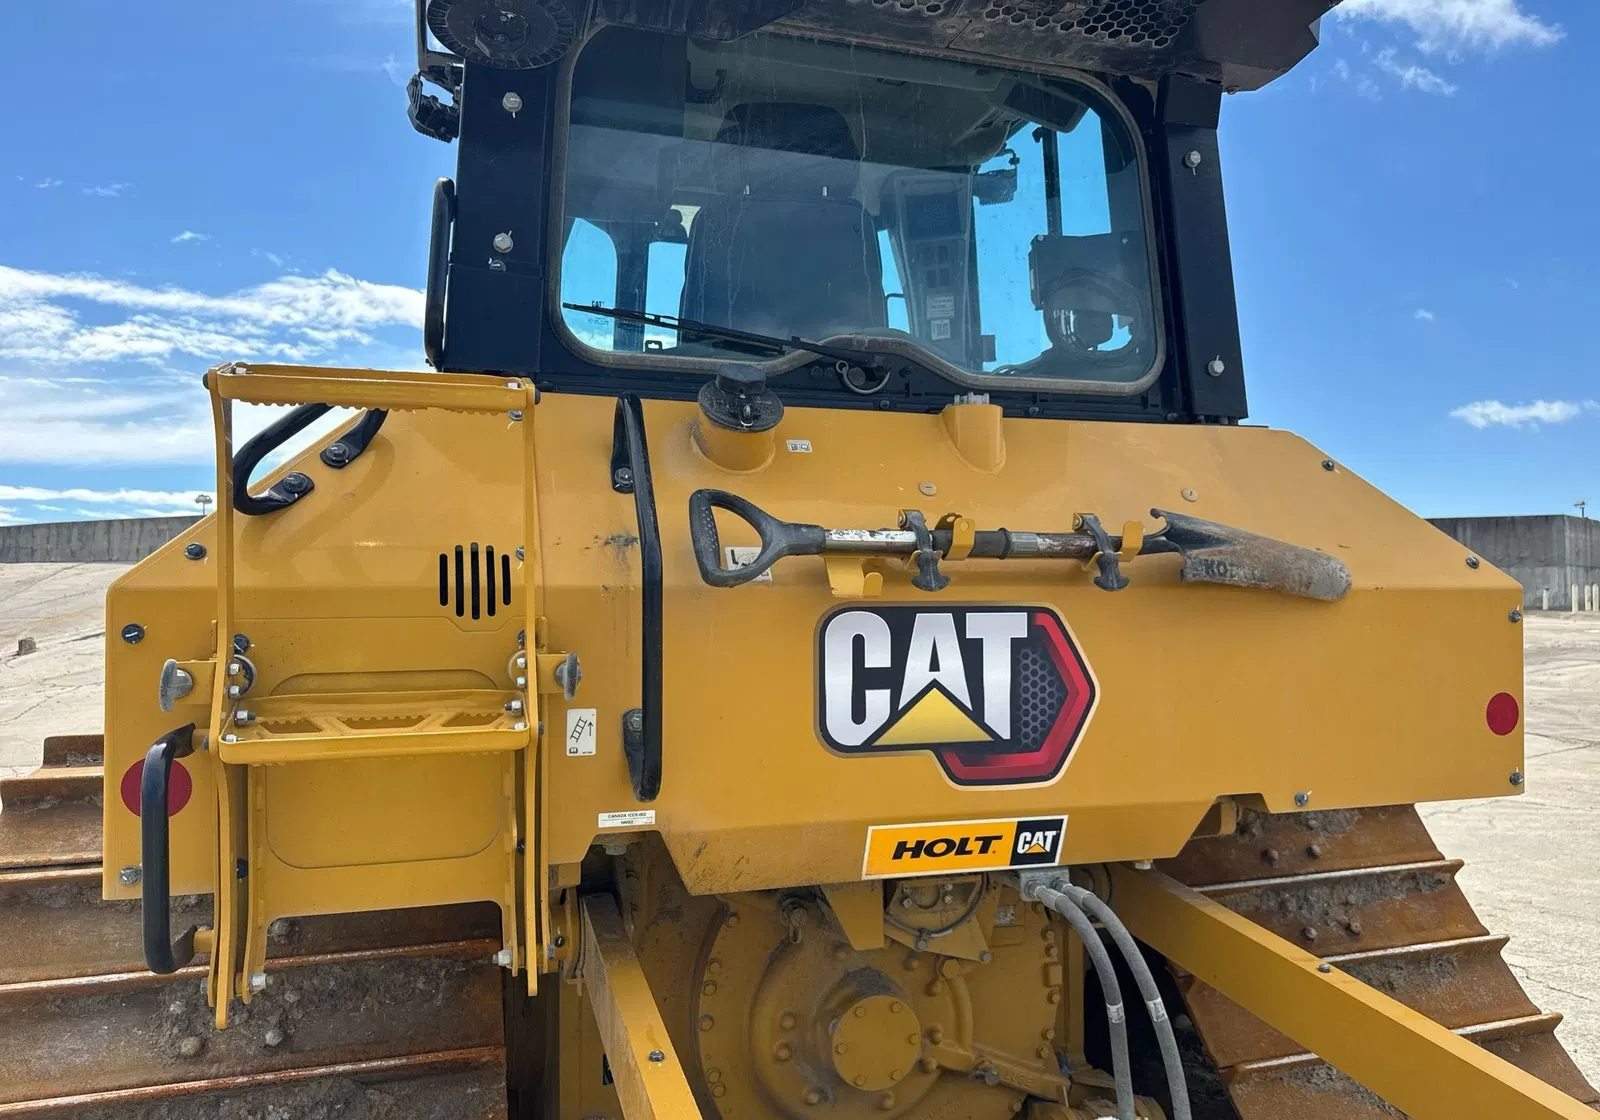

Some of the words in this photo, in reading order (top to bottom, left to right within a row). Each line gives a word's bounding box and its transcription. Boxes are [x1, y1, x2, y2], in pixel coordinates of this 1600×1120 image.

[824, 610, 1028, 746] CAT
[892, 835, 1003, 860] HOLT
[1016, 831, 1057, 855] CAT
